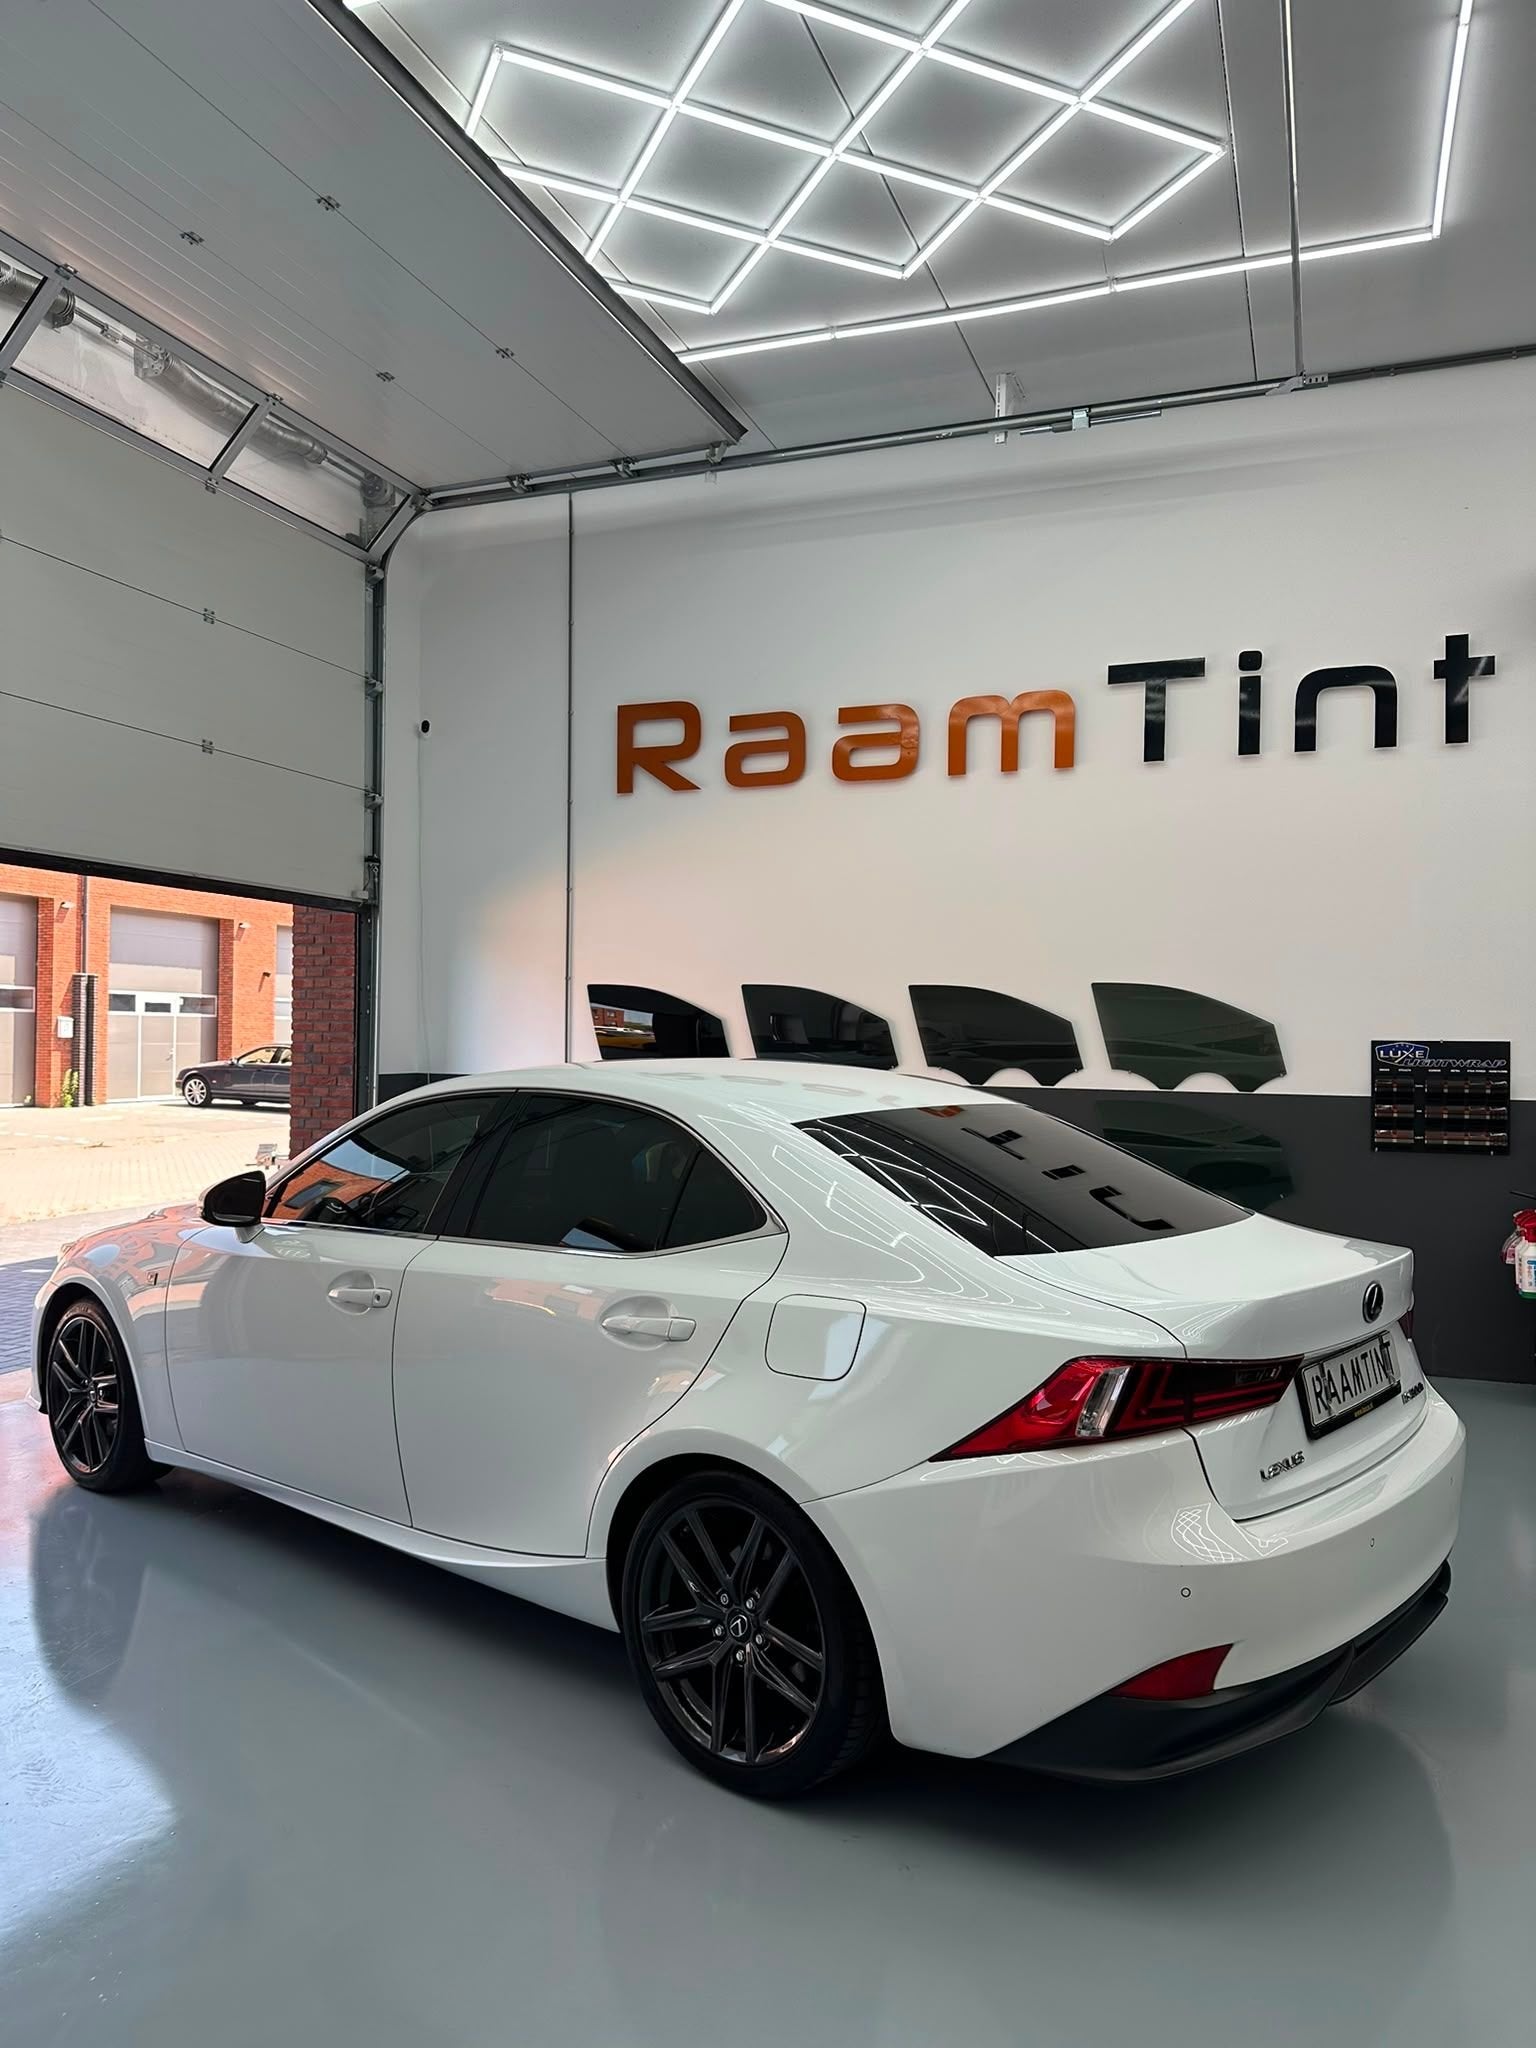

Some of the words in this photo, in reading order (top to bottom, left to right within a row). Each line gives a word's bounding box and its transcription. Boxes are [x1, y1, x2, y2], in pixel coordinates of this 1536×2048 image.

[616, 633, 1496, 795] RaamTint
[1380, 1048, 1425, 1061] LUXE
[1312, 1340, 1395, 1415] RAAMTINT
[1260, 1450, 1305, 1482] LEXUS
